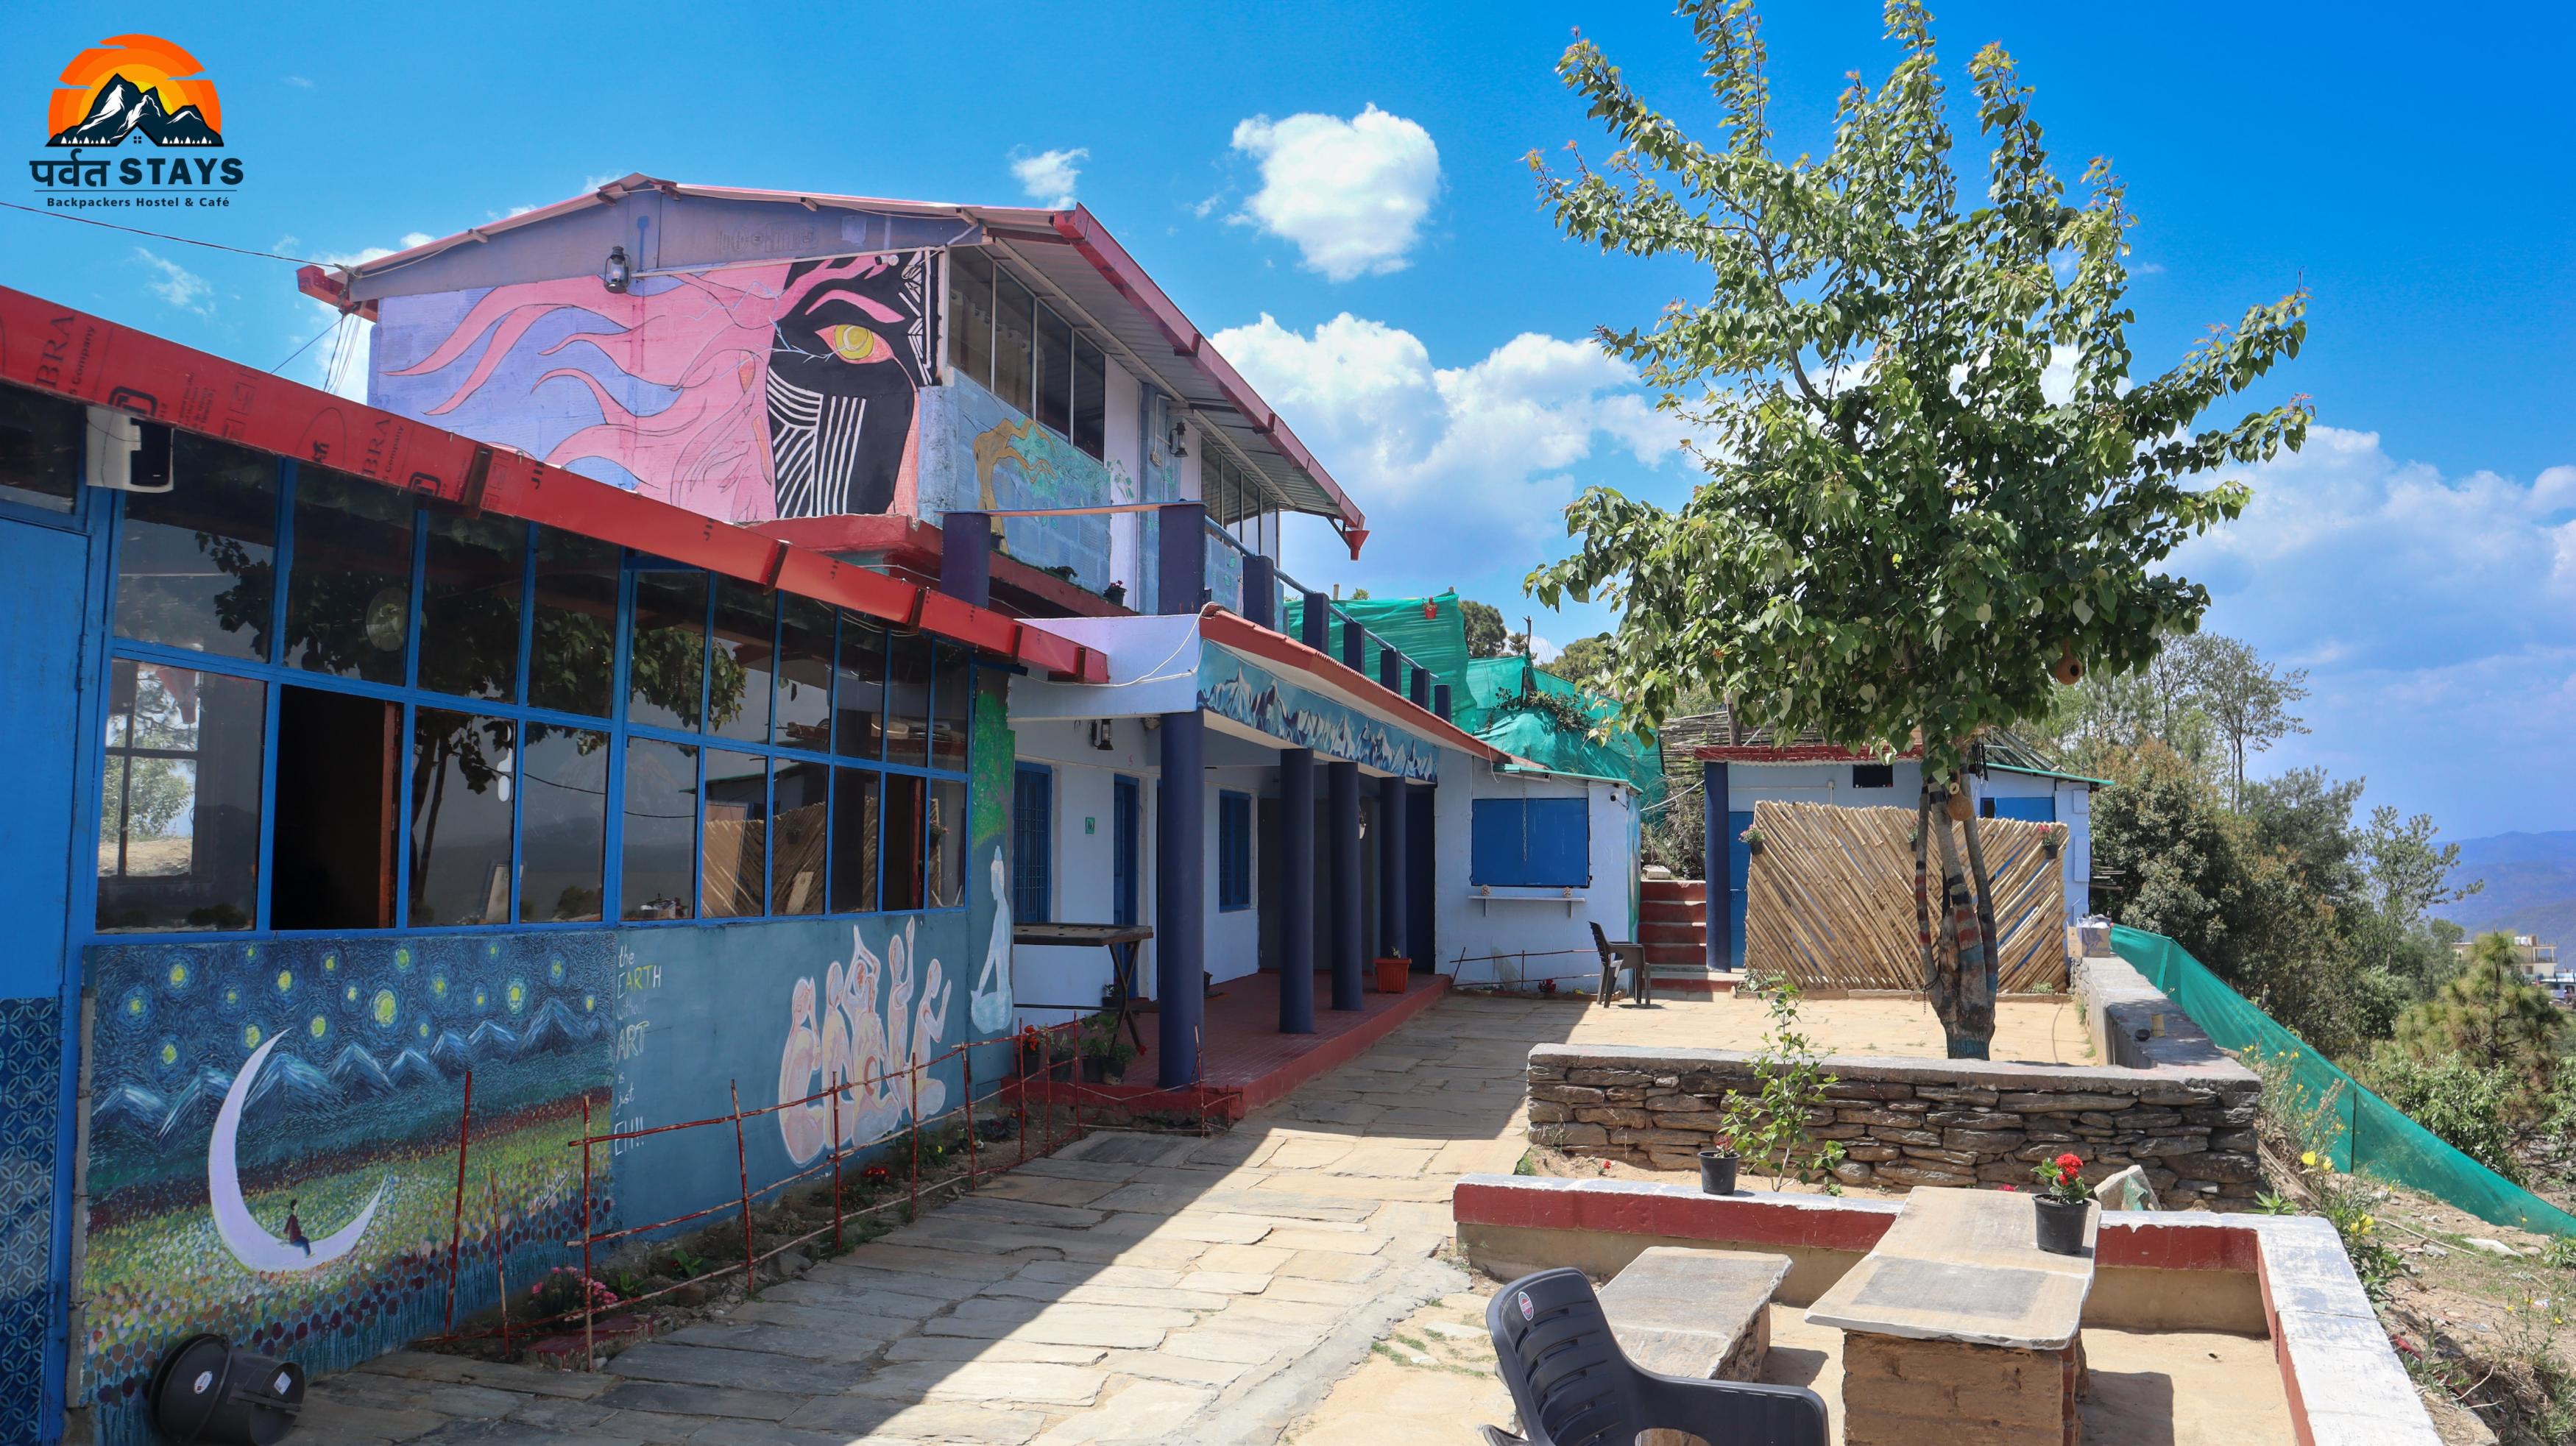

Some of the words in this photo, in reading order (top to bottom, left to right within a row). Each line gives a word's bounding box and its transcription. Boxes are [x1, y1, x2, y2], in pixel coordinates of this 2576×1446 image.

[72, 326, 95, 384] Company
[386, 425, 405, 472] Company
[618, 944, 635, 968] the
[618, 965, 662, 999] EARTH
[616, 1021, 650, 1064] ART
[615, 1082, 635, 1116] just
